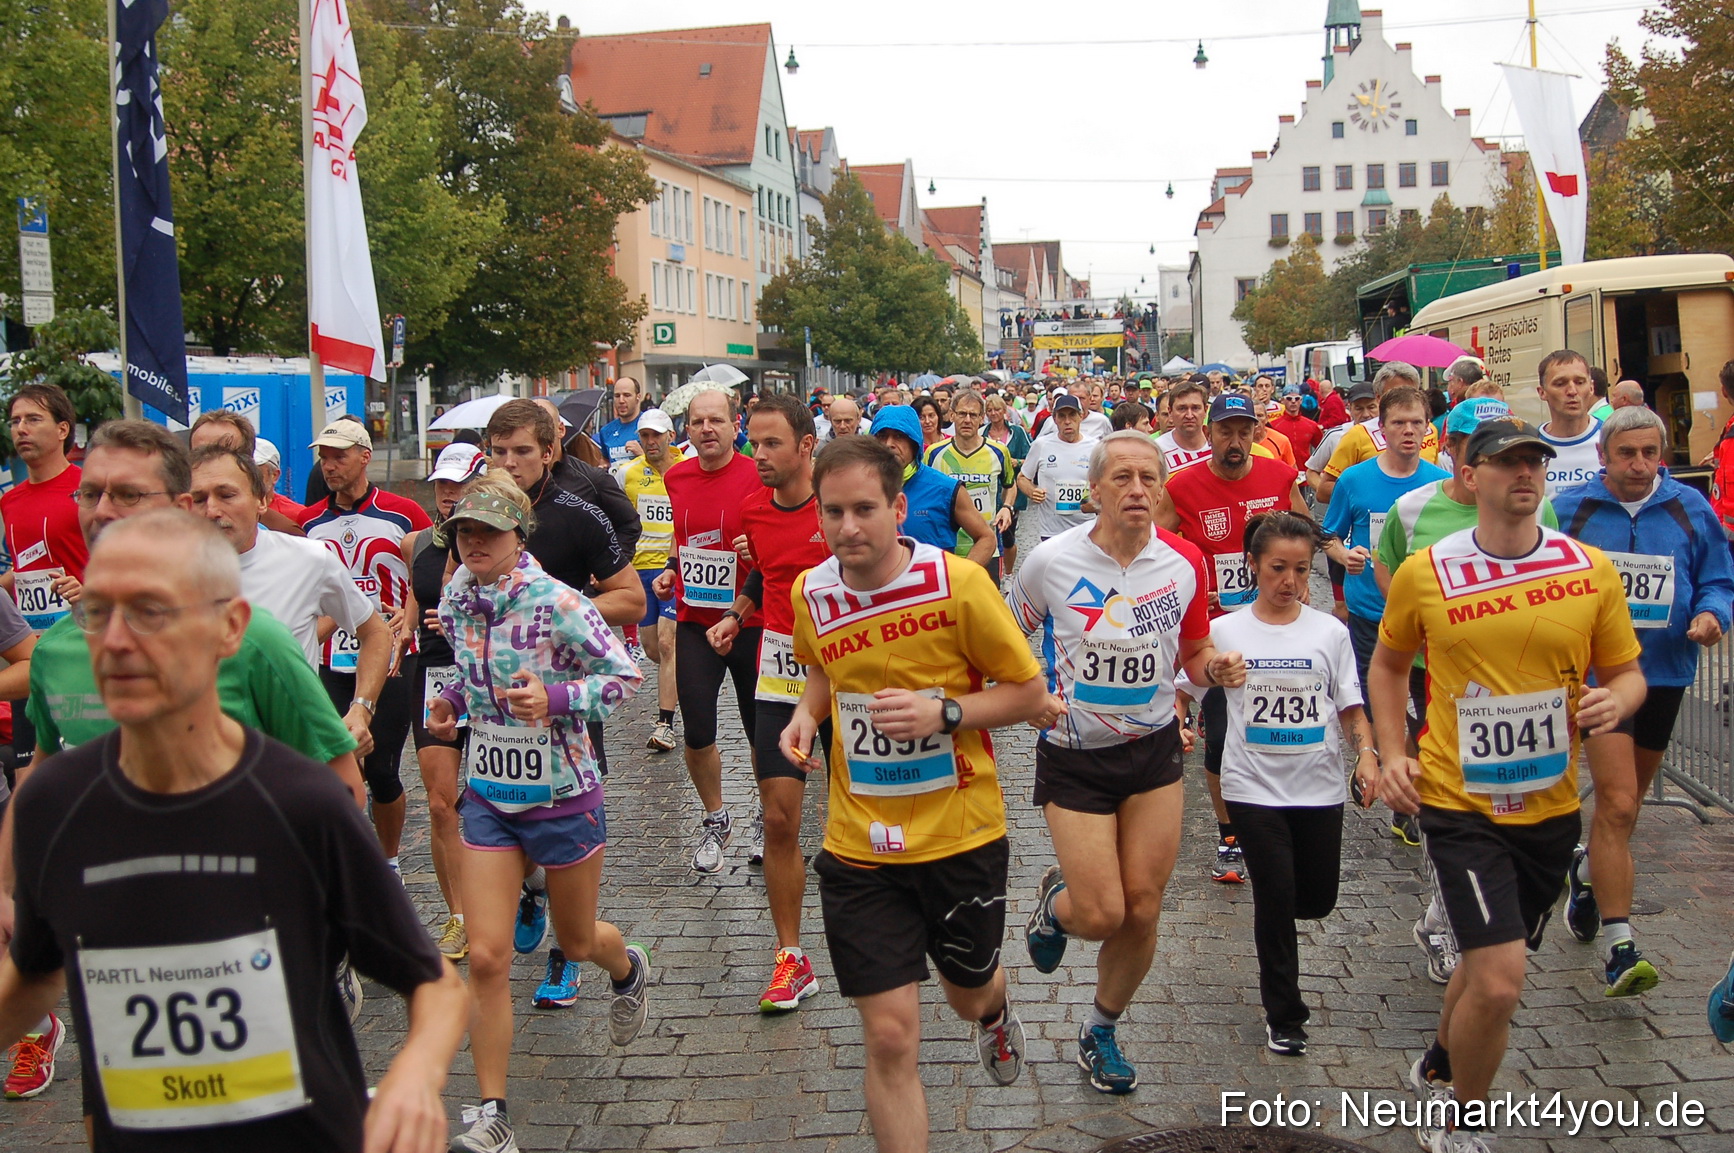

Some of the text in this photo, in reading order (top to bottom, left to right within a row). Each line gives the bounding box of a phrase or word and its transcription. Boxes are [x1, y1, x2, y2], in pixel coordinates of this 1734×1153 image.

[656, 325, 673, 342] D
[1489, 317, 1538, 343] Bayerisches
[1062, 338, 1093, 347] START
[1489, 346, 1511, 364] Rotes
[1489, 370, 1511, 386] Kreuz
[1204, 512, 1225, 521] IMMER
[1204, 517, 1227, 525] WIEDER
[1207, 522, 1227, 531] NEU
[696, 554, 726, 563] Neumarkt
[1623, 561, 1662, 571] Neumarkt
[682, 561, 731, 587] 2302
[18, 587, 63, 612] 2304
[686, 587, 723, 600] Johannes
[1137, 579, 1177, 604] memmert
[1132, 590, 1180, 623] ROTHSEE
[1447, 578, 1599, 625] MAX BÖGL
[1128, 606, 1182, 638] TRIATHLON
[764, 636, 794, 649] PARTL Neu
[820, 610, 957, 665] MAX BÖGL
[1109, 643, 1149, 654] Neumarkt
[1082, 650, 1156, 684] 3189
[786, 682, 800, 695] Uli
[1247, 683, 1312, 693] PARTL Neumarkt
[840, 702, 871, 714] PARTL
[1252, 695, 1319, 724] 2434
[1459, 702, 1548, 718] PARTL Neumarkt
[472, 728, 534, 745] PARTL Neumarkt
[1270, 731, 1304, 743] Maika
[1469, 713, 1556, 759] 3041
[475, 743, 542, 781] 3009
[874, 765, 921, 782] Stefan
[1497, 763, 1538, 782] Ralph
[486, 785, 527, 801] Claudia
[86, 959, 243, 985] PARTL Neumarkt
[125, 986, 248, 1059] 263
[162, 1073, 228, 1102] Skott
